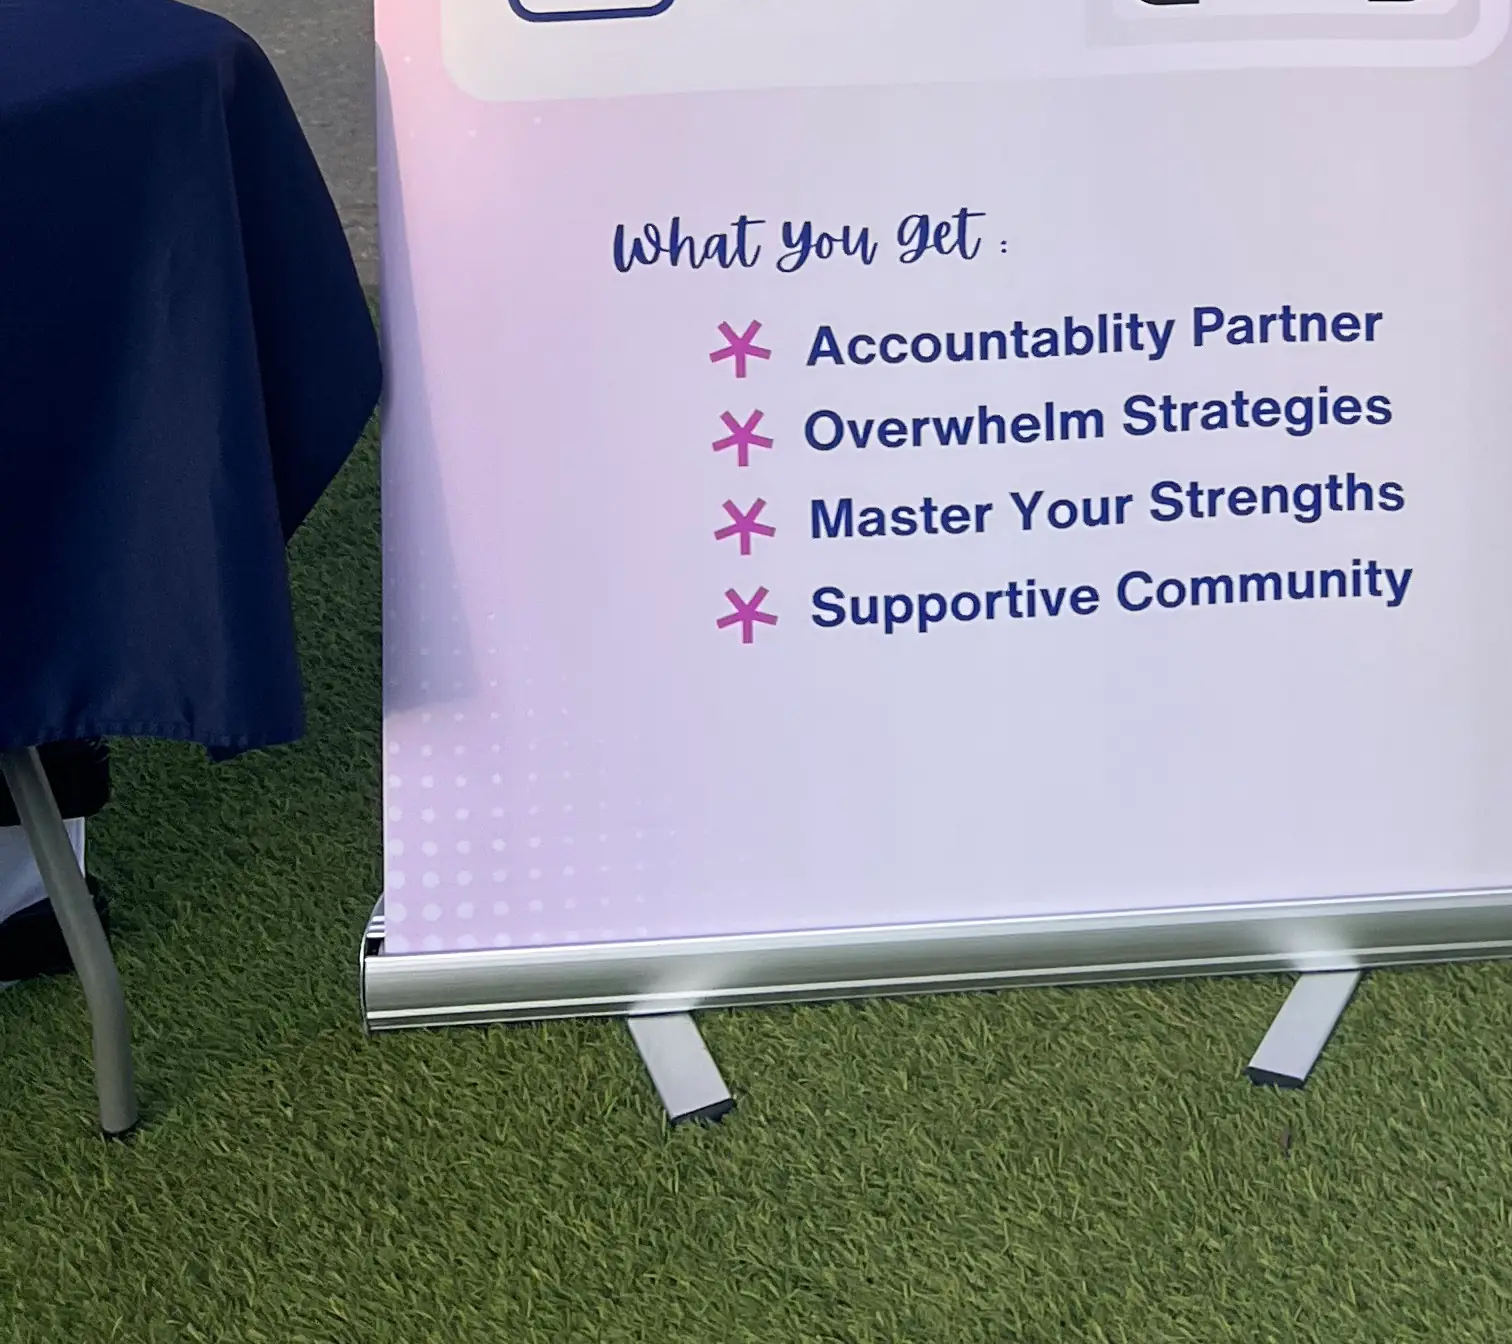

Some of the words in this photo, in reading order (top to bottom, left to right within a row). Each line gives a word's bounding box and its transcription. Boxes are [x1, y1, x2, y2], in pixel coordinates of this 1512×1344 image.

[612, 214, 767, 274] What
[806, 312, 1176, 367] Accountablity
[1193, 304, 1384, 348] Partner
[804, 400, 1105, 452] Overwhelm
[1122, 385, 1393, 438] Strategies
[811, 496, 994, 540] Master
[1009, 490, 1134, 531] Your
[1149, 471, 1406, 524] Strengths
[811, 578, 1101, 635] Supportive
[1116, 558, 1415, 612] Community
